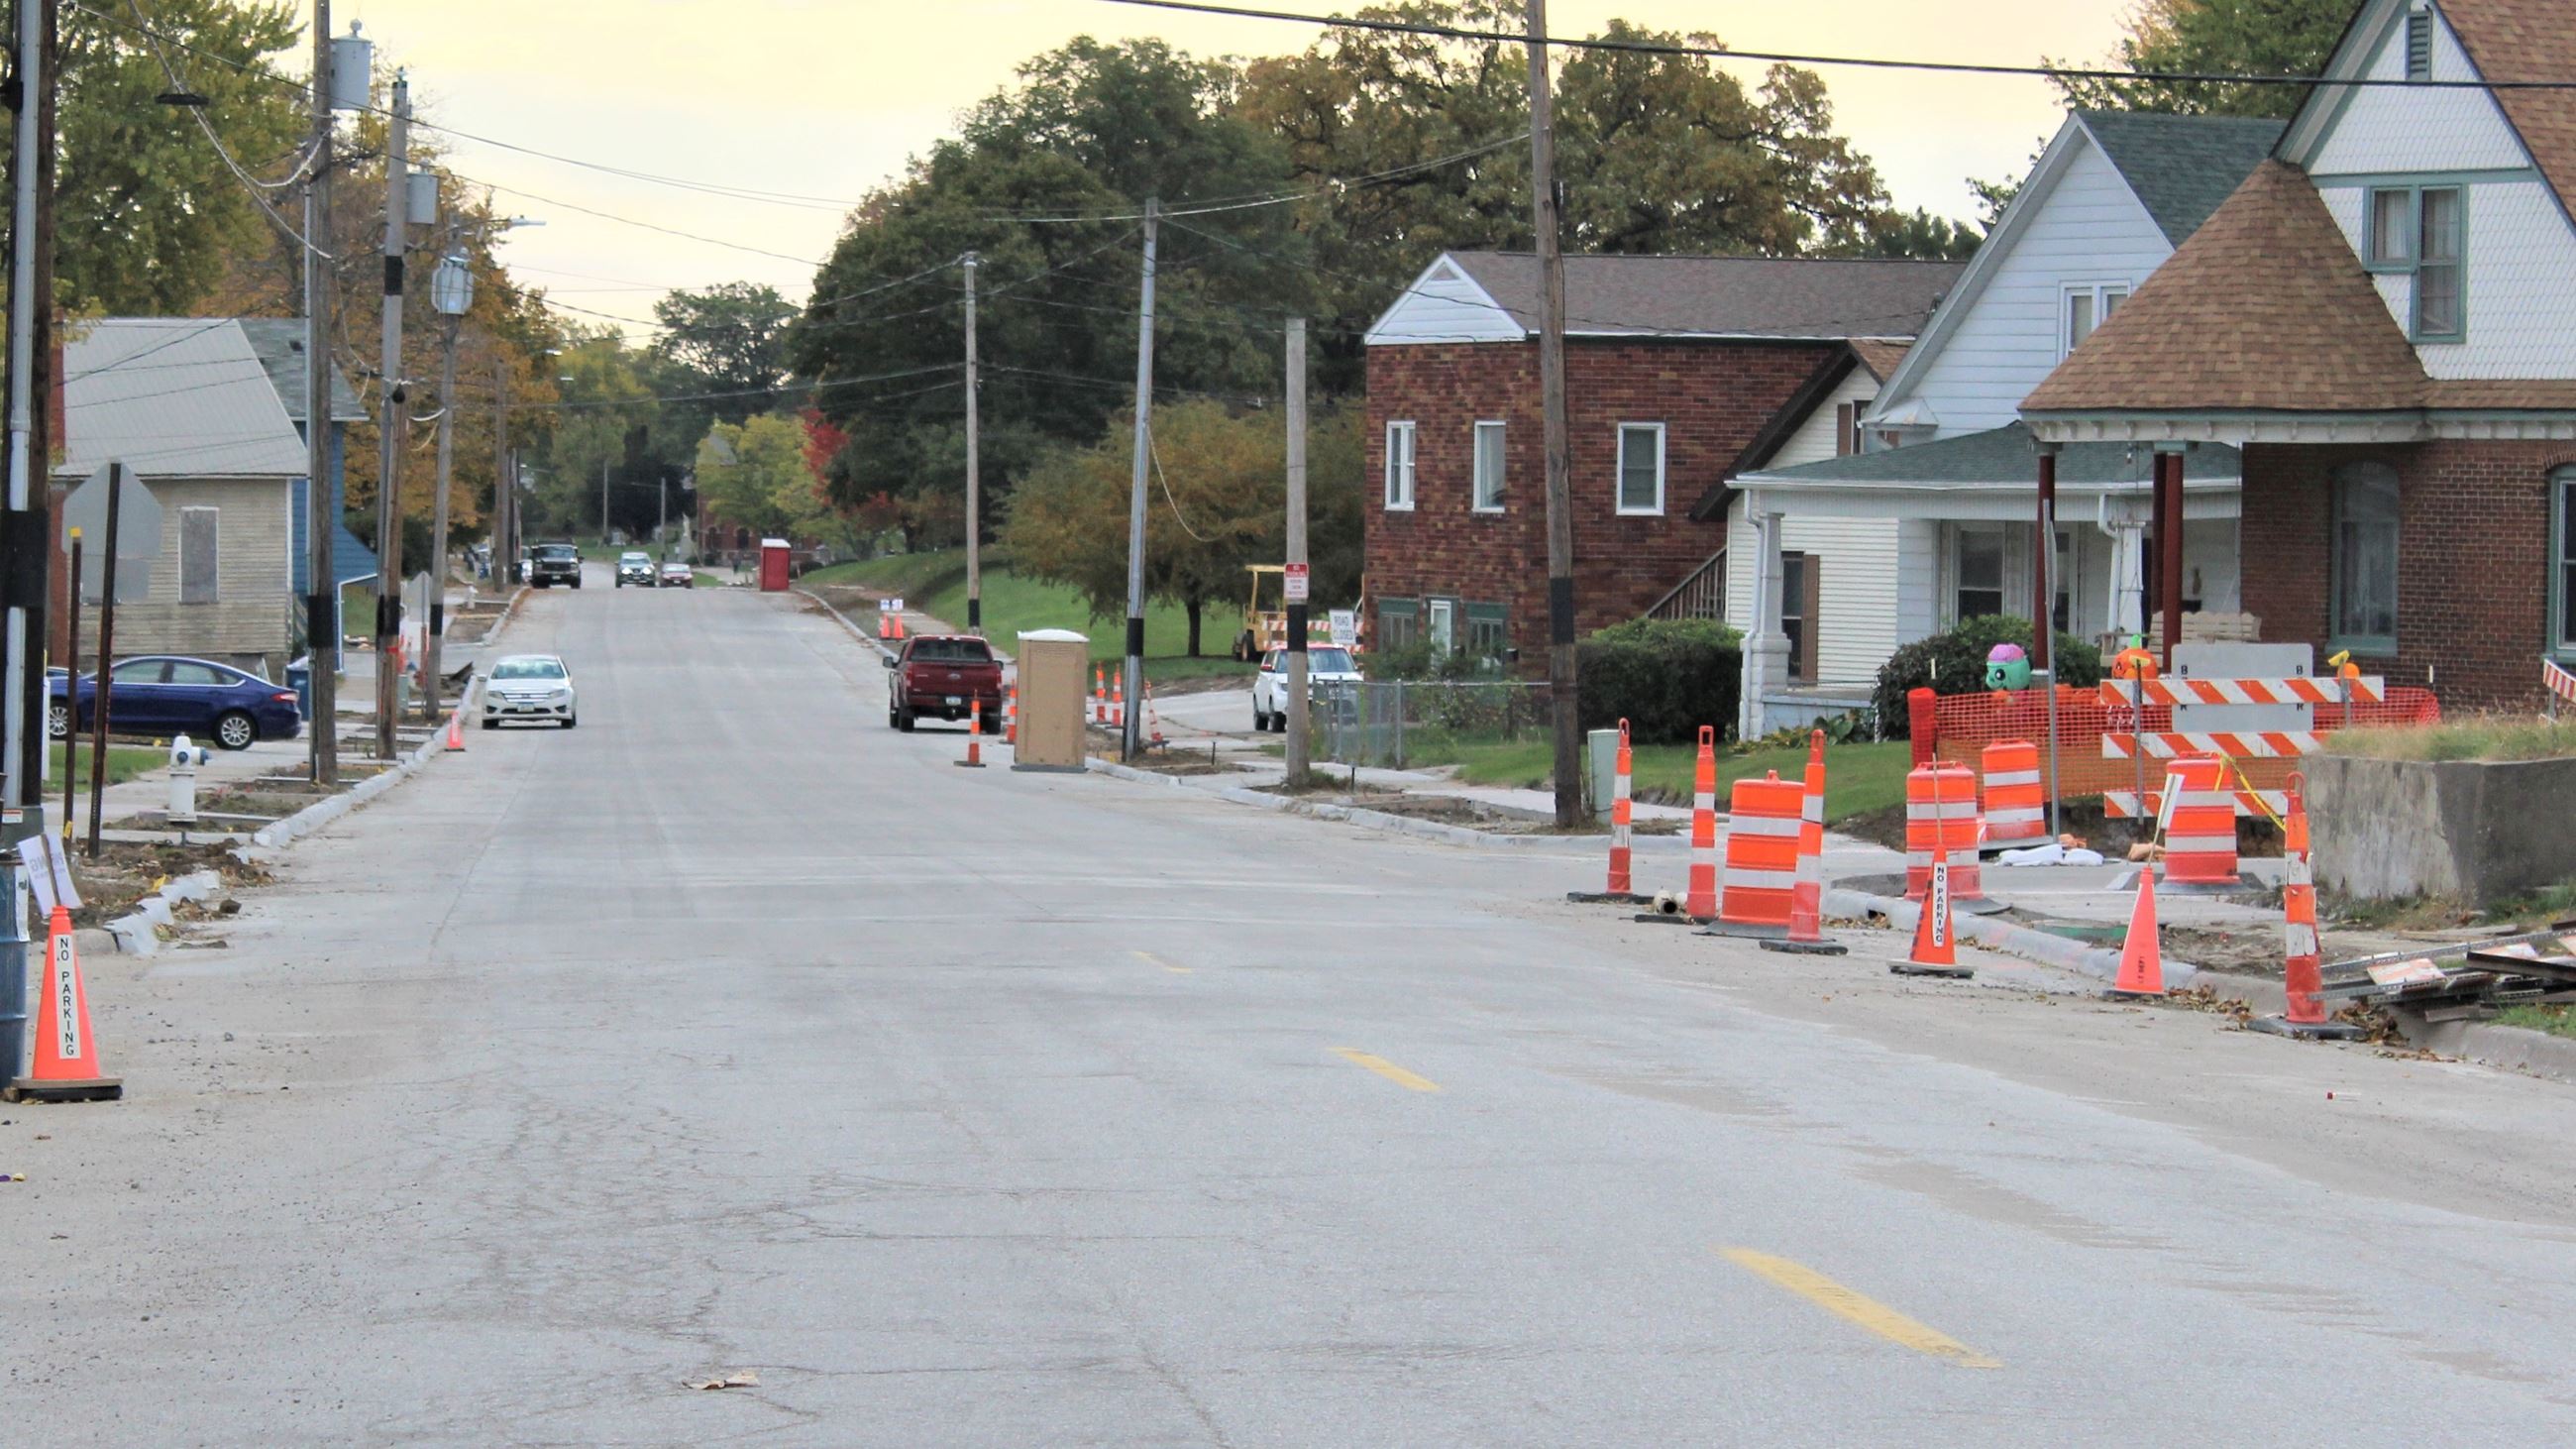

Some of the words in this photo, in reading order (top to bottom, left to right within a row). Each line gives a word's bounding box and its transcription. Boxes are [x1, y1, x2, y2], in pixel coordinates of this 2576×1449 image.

[1937, 866, 1945, 882] NO
[60, 938, 69, 960] NO
[61, 971, 74, 1056] PARKING
